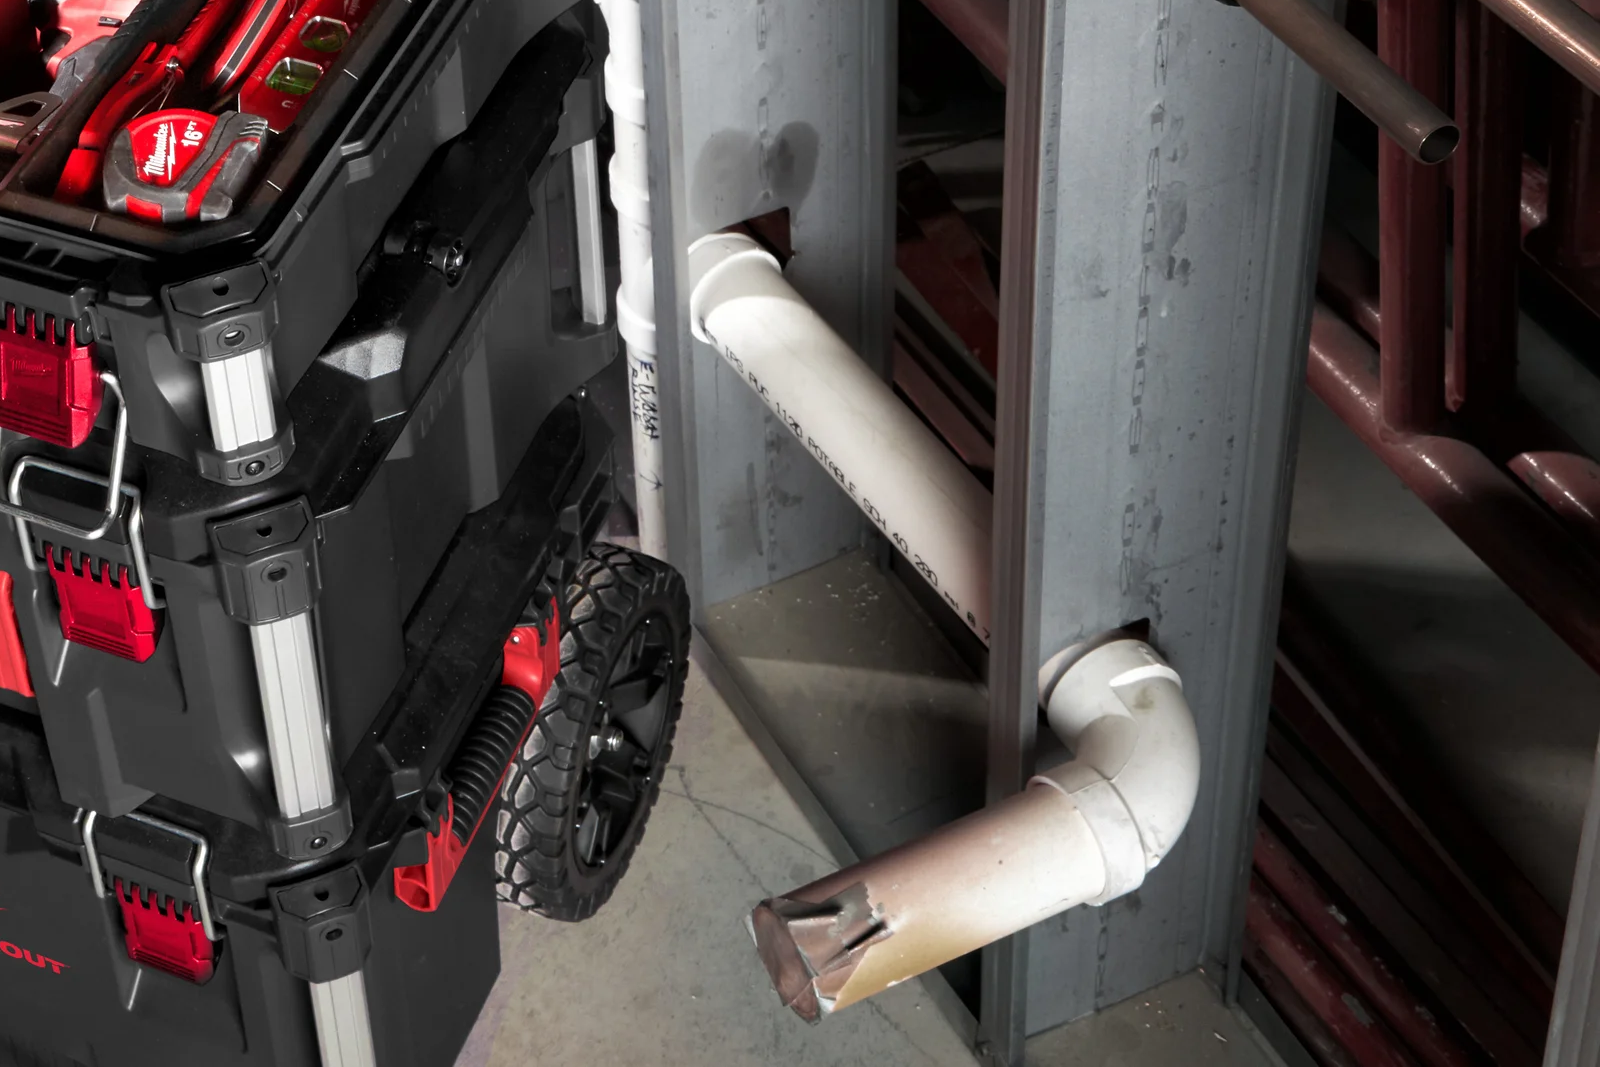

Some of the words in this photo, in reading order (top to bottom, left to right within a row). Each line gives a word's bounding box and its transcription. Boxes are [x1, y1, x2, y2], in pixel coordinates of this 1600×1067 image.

[143, 122, 169, 177] Milwaukee
[775, 402, 803, 438] 1120
[807, 436, 857, 499] POTABLE
[892, 532, 909, 554] 40
